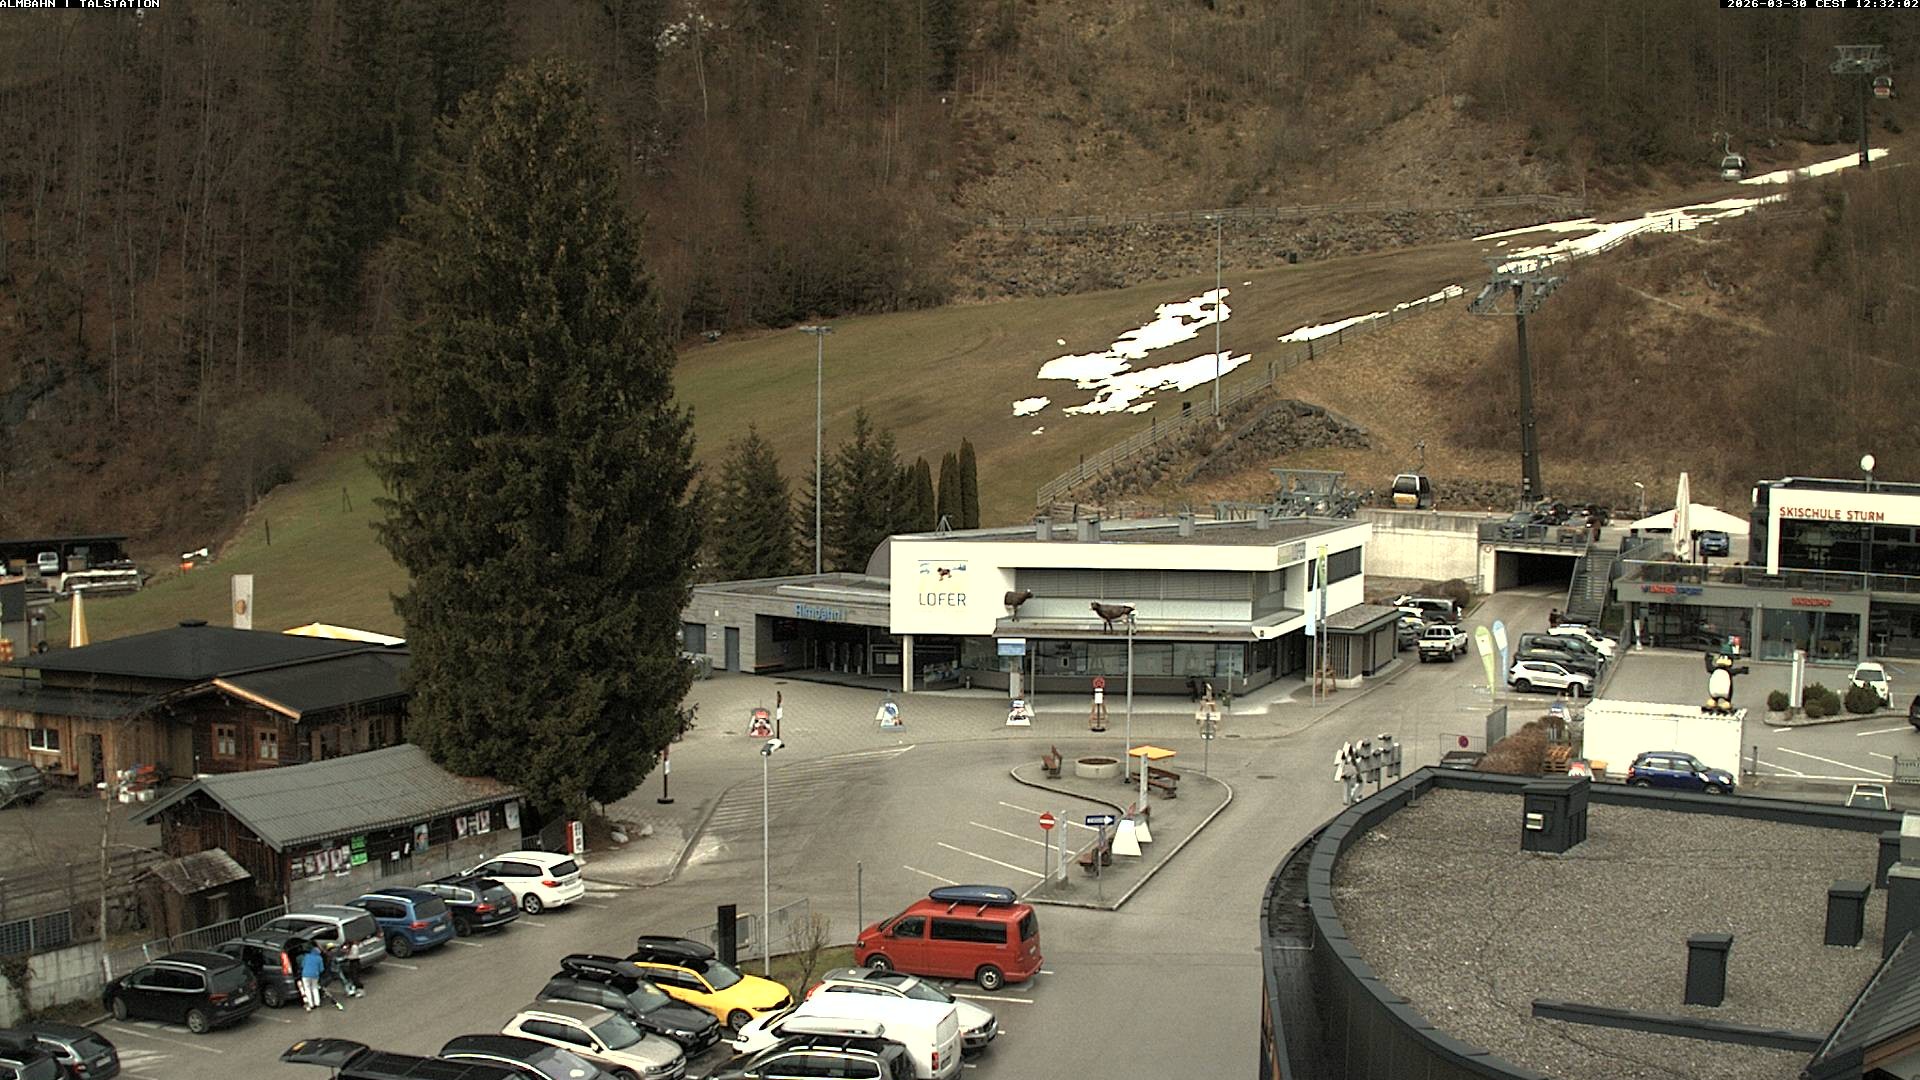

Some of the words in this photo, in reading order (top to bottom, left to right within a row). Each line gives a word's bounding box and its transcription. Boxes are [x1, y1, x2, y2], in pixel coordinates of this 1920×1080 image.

[1779, 506, 1841, 520] SKISCHULE
[1847, 510, 1885, 521] STURM
[918, 592, 967, 607] LOFER
